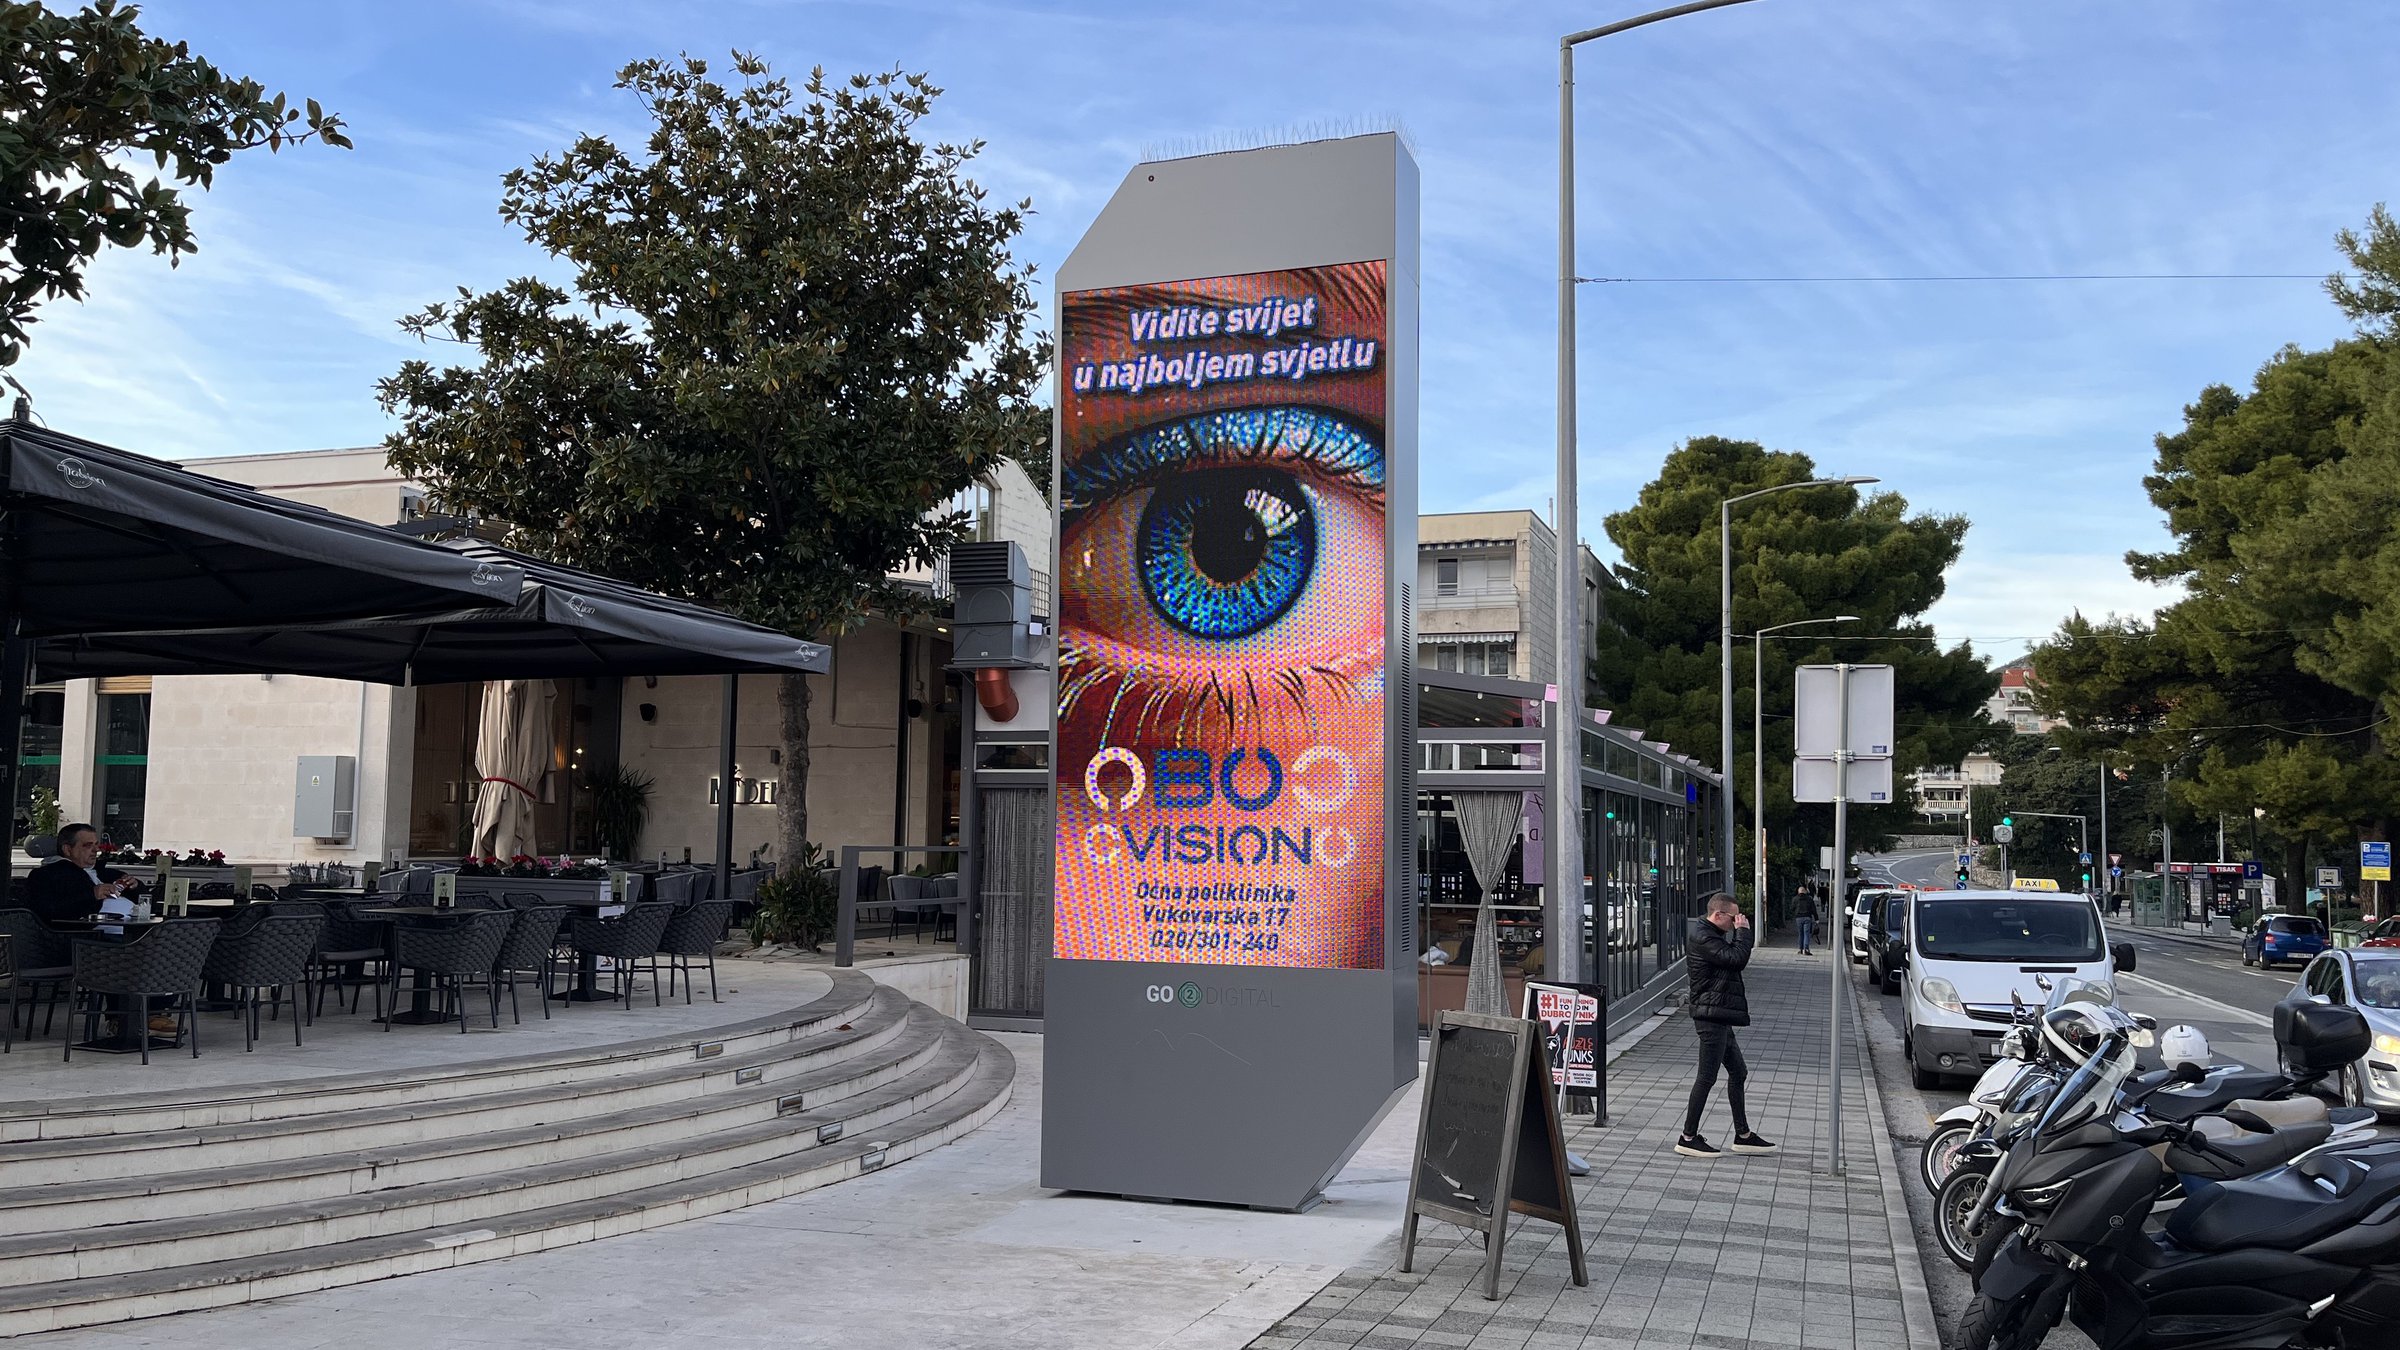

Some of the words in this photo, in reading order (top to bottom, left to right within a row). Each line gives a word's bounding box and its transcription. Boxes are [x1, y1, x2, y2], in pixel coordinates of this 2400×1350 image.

[1130, 308, 1219, 340] Vidite
[1225, 298, 1316, 337] svijet
[1074, 366, 1093, 390] u
[1099, 353, 1254, 393] najboljem
[1262, 339, 1376, 379] svjetlu
[1186, 882, 1296, 905] poliklinika
[2019, 879, 2041, 888] TAXI
[1143, 904, 1259, 925] Vukovarska
[1266, 907, 1290, 926] 17
[1152, 929, 1279, 951] 020/301-240
[1146, 984, 1175, 1003] GO
[1206, 986, 1281, 1008] DIGITAL
[1540, 994, 1558, 1009] #1
